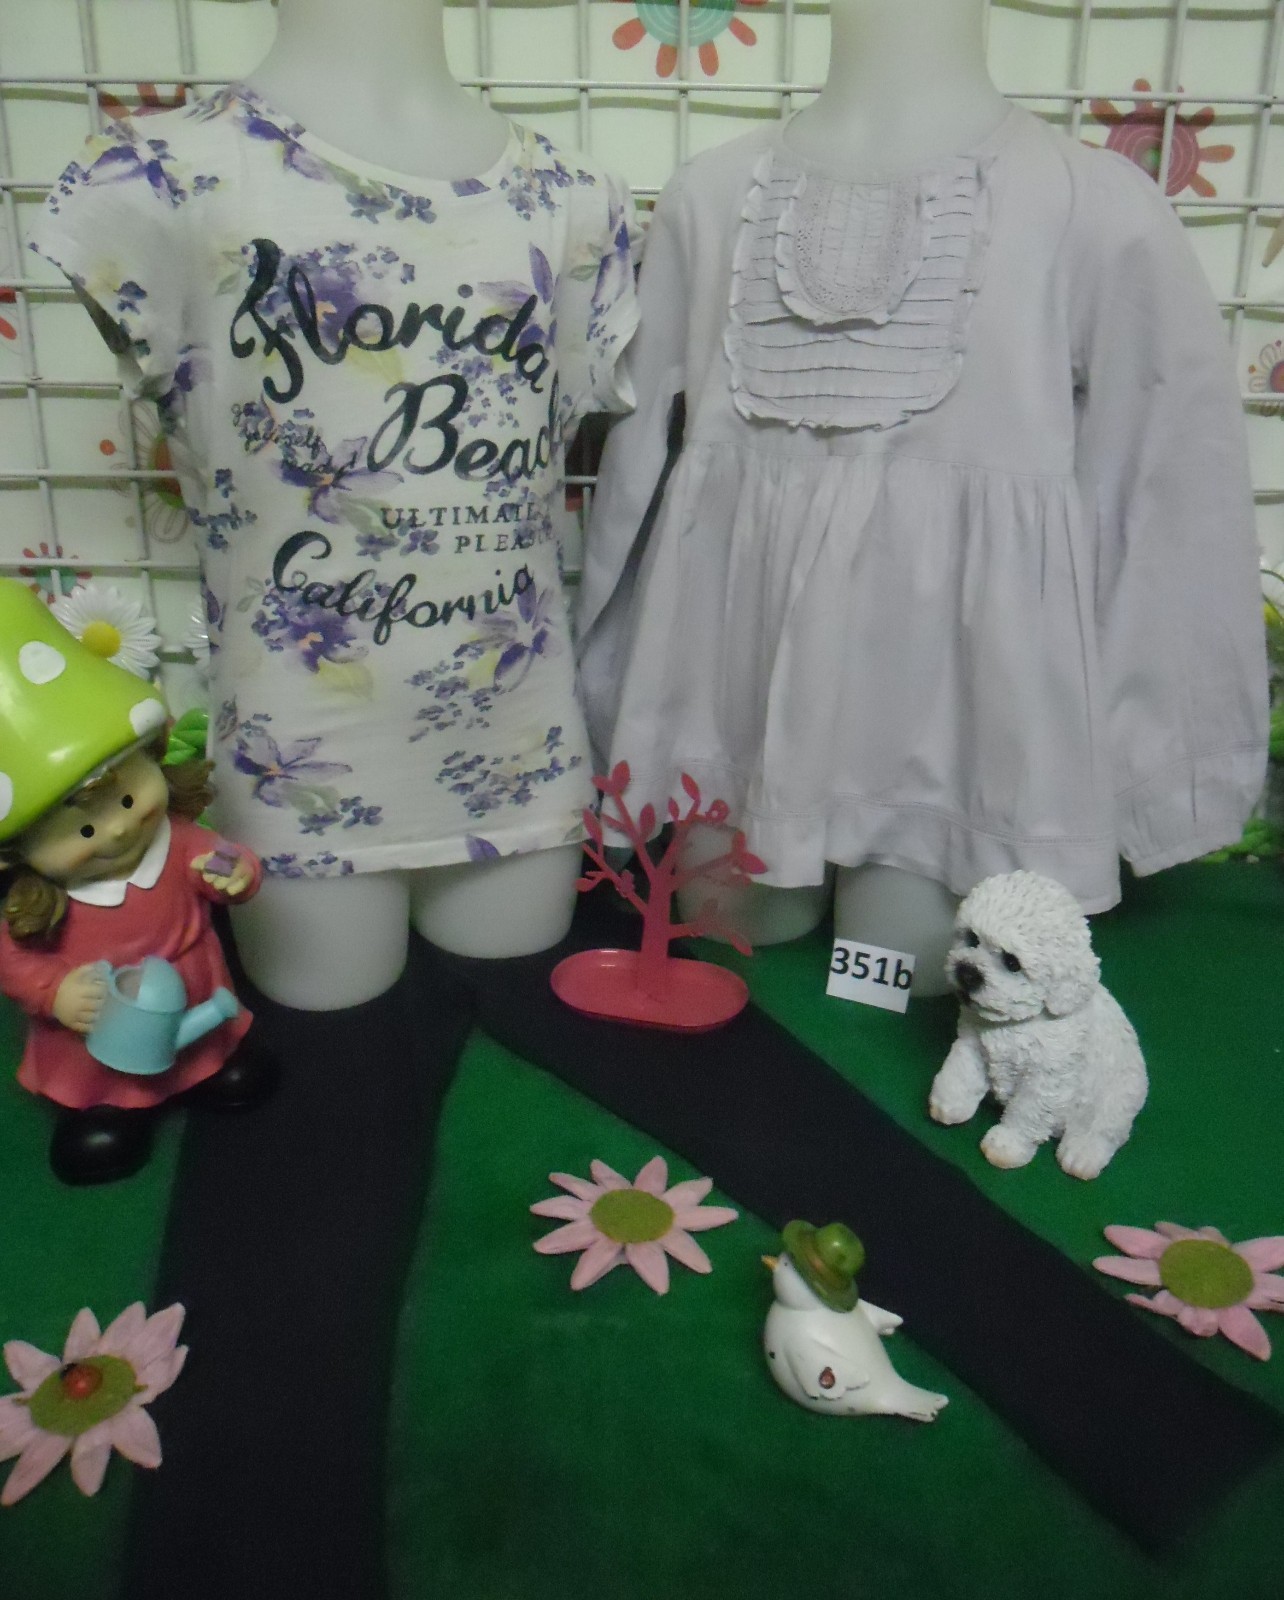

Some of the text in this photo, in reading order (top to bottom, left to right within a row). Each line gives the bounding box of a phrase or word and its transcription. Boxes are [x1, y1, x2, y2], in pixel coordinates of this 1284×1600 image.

[230, 238, 549, 403] Florida
[454, 528, 553, 554] PLEAS
[272, 530, 534, 645] California
[830, 946, 913, 991] 351b
